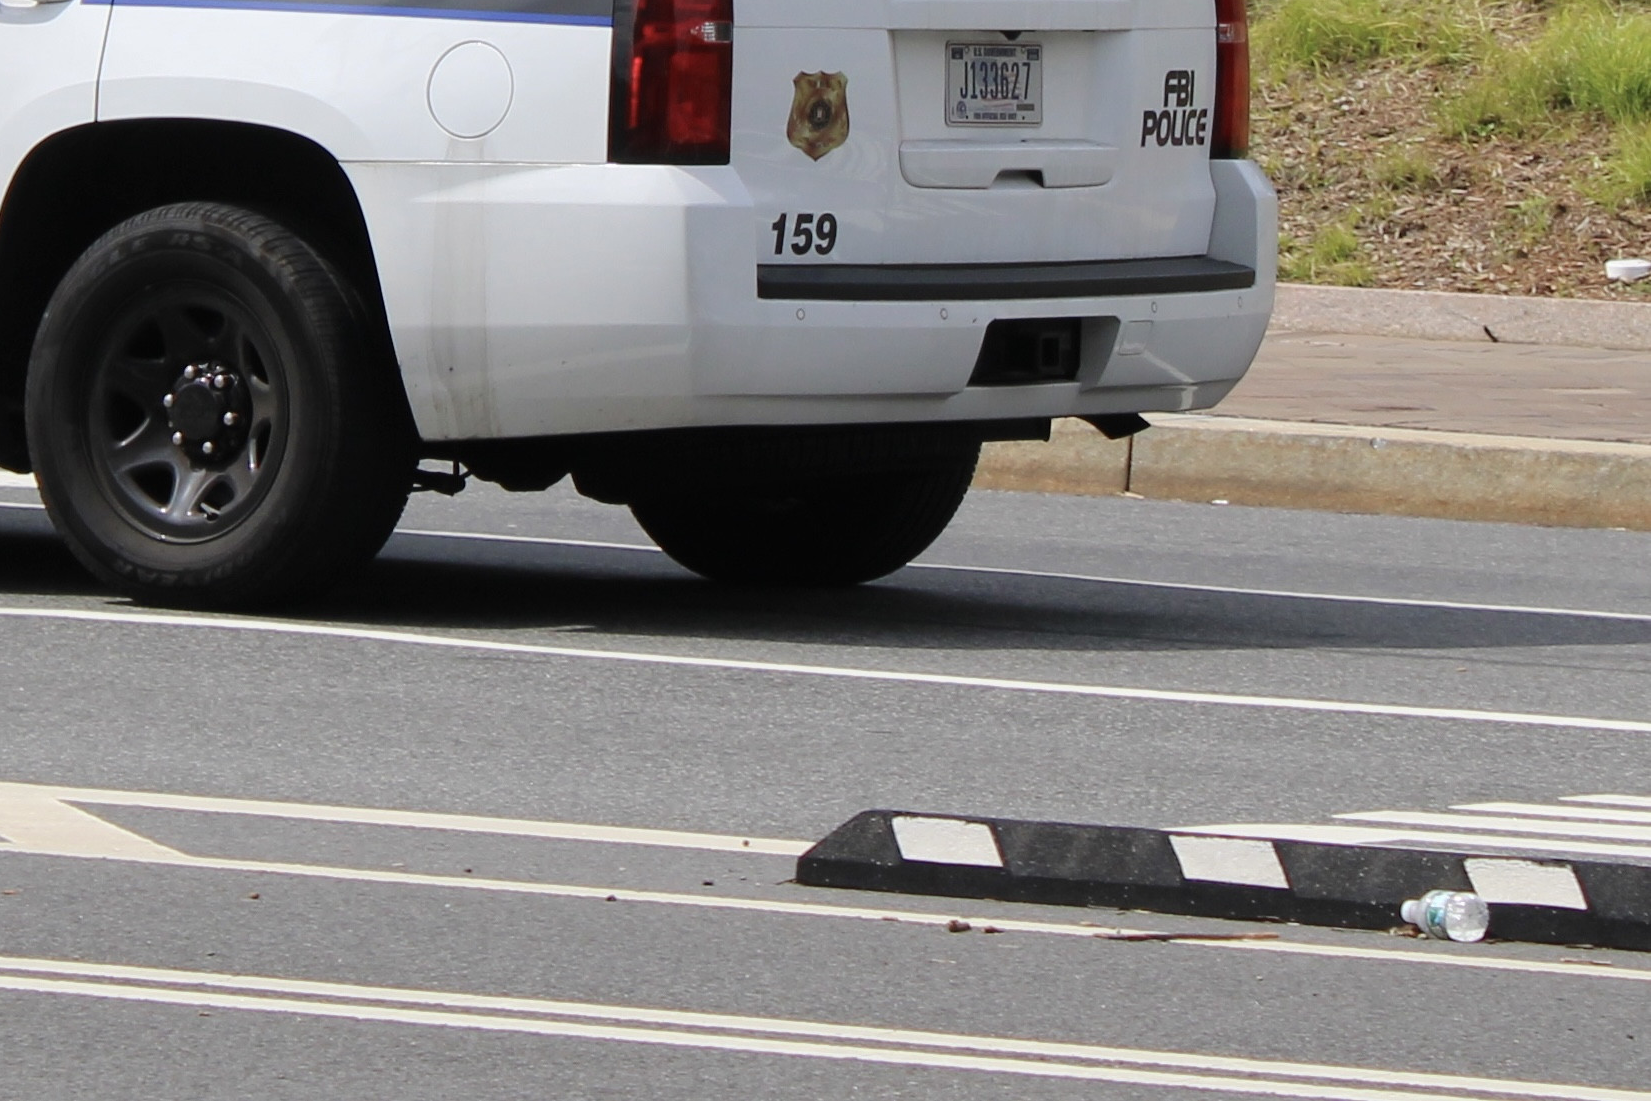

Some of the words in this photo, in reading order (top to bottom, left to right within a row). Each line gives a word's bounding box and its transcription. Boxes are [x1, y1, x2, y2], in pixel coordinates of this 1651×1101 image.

[959, 60, 1031, 101] J133627
[1163, 69, 1195, 108] FBI
[1140, 107, 1208, 148] POLICE
[771, 212, 838, 256] 159
